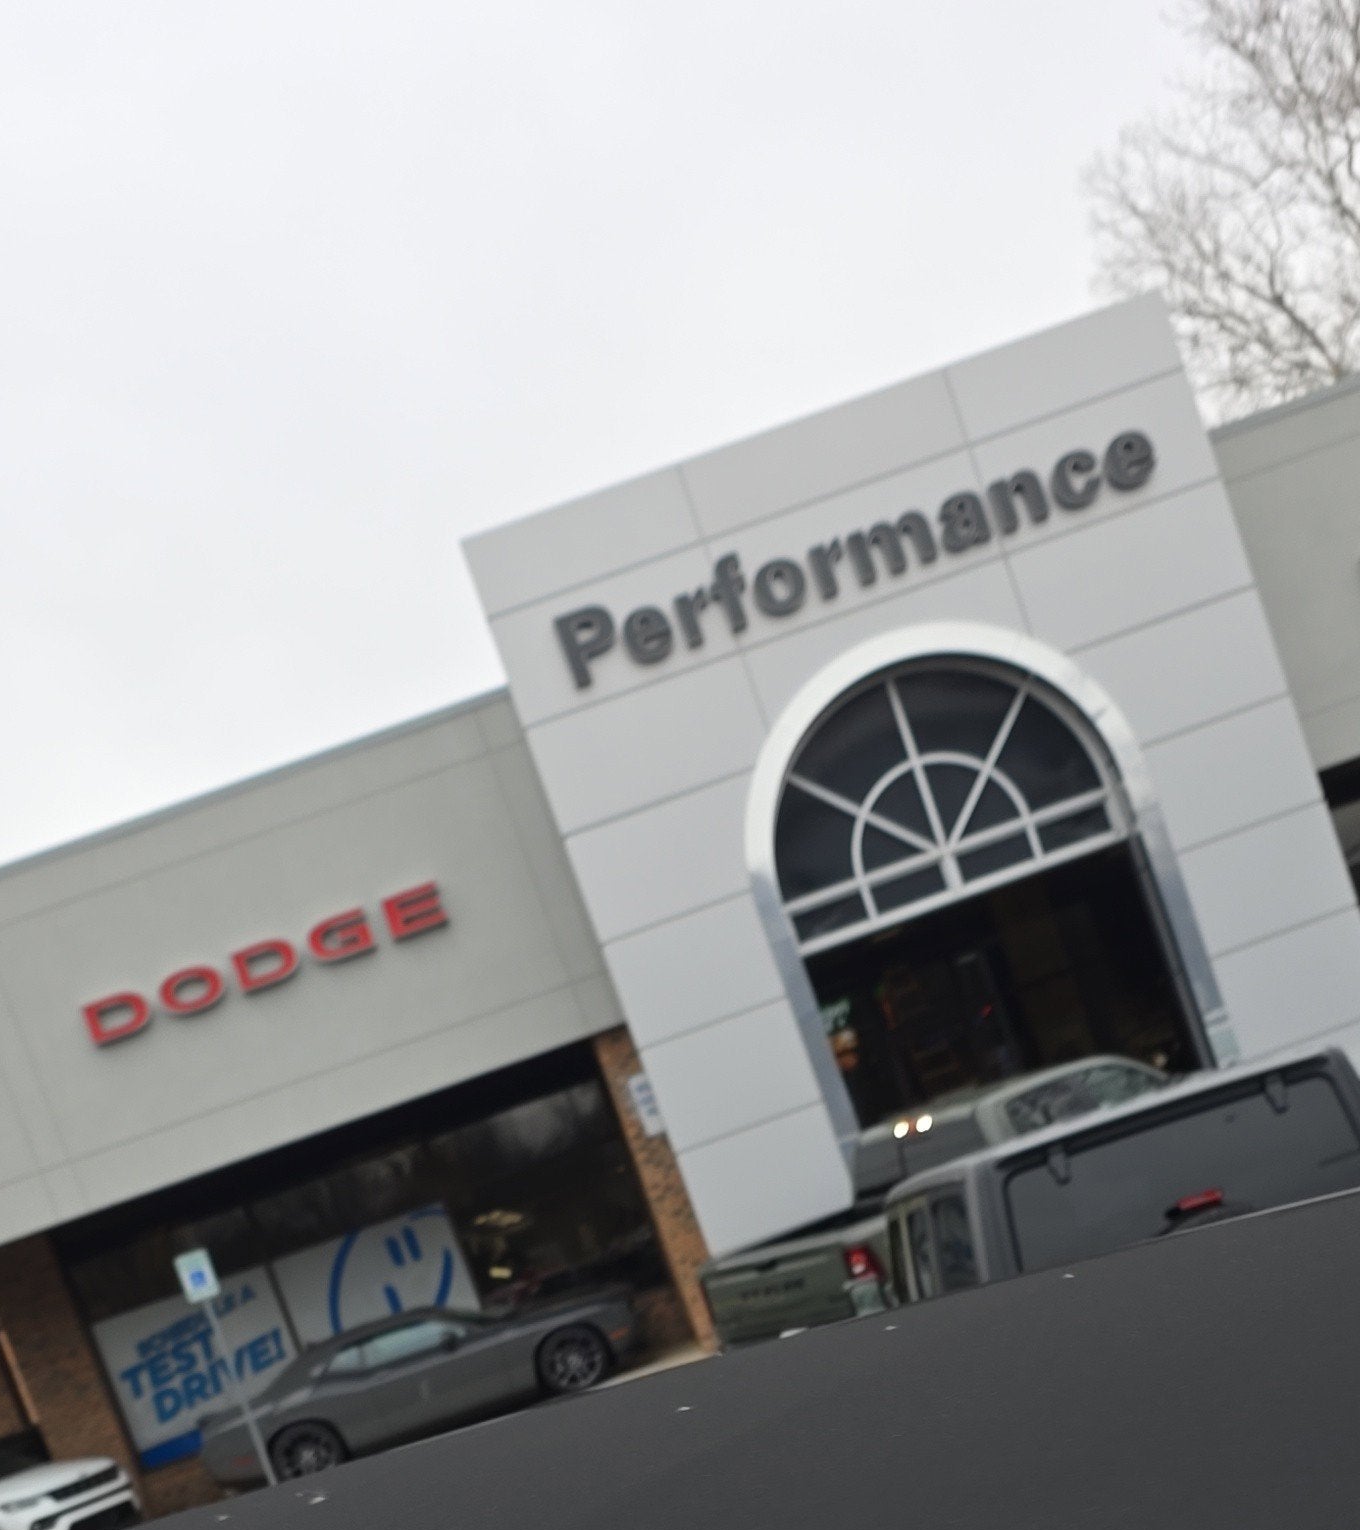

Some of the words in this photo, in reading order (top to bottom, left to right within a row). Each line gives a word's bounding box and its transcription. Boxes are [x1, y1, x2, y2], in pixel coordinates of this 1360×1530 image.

[553, 430, 1157, 691] Performance
[82, 880, 449, 1046] DODGE
[119, 1324, 214, 1399] TEST
